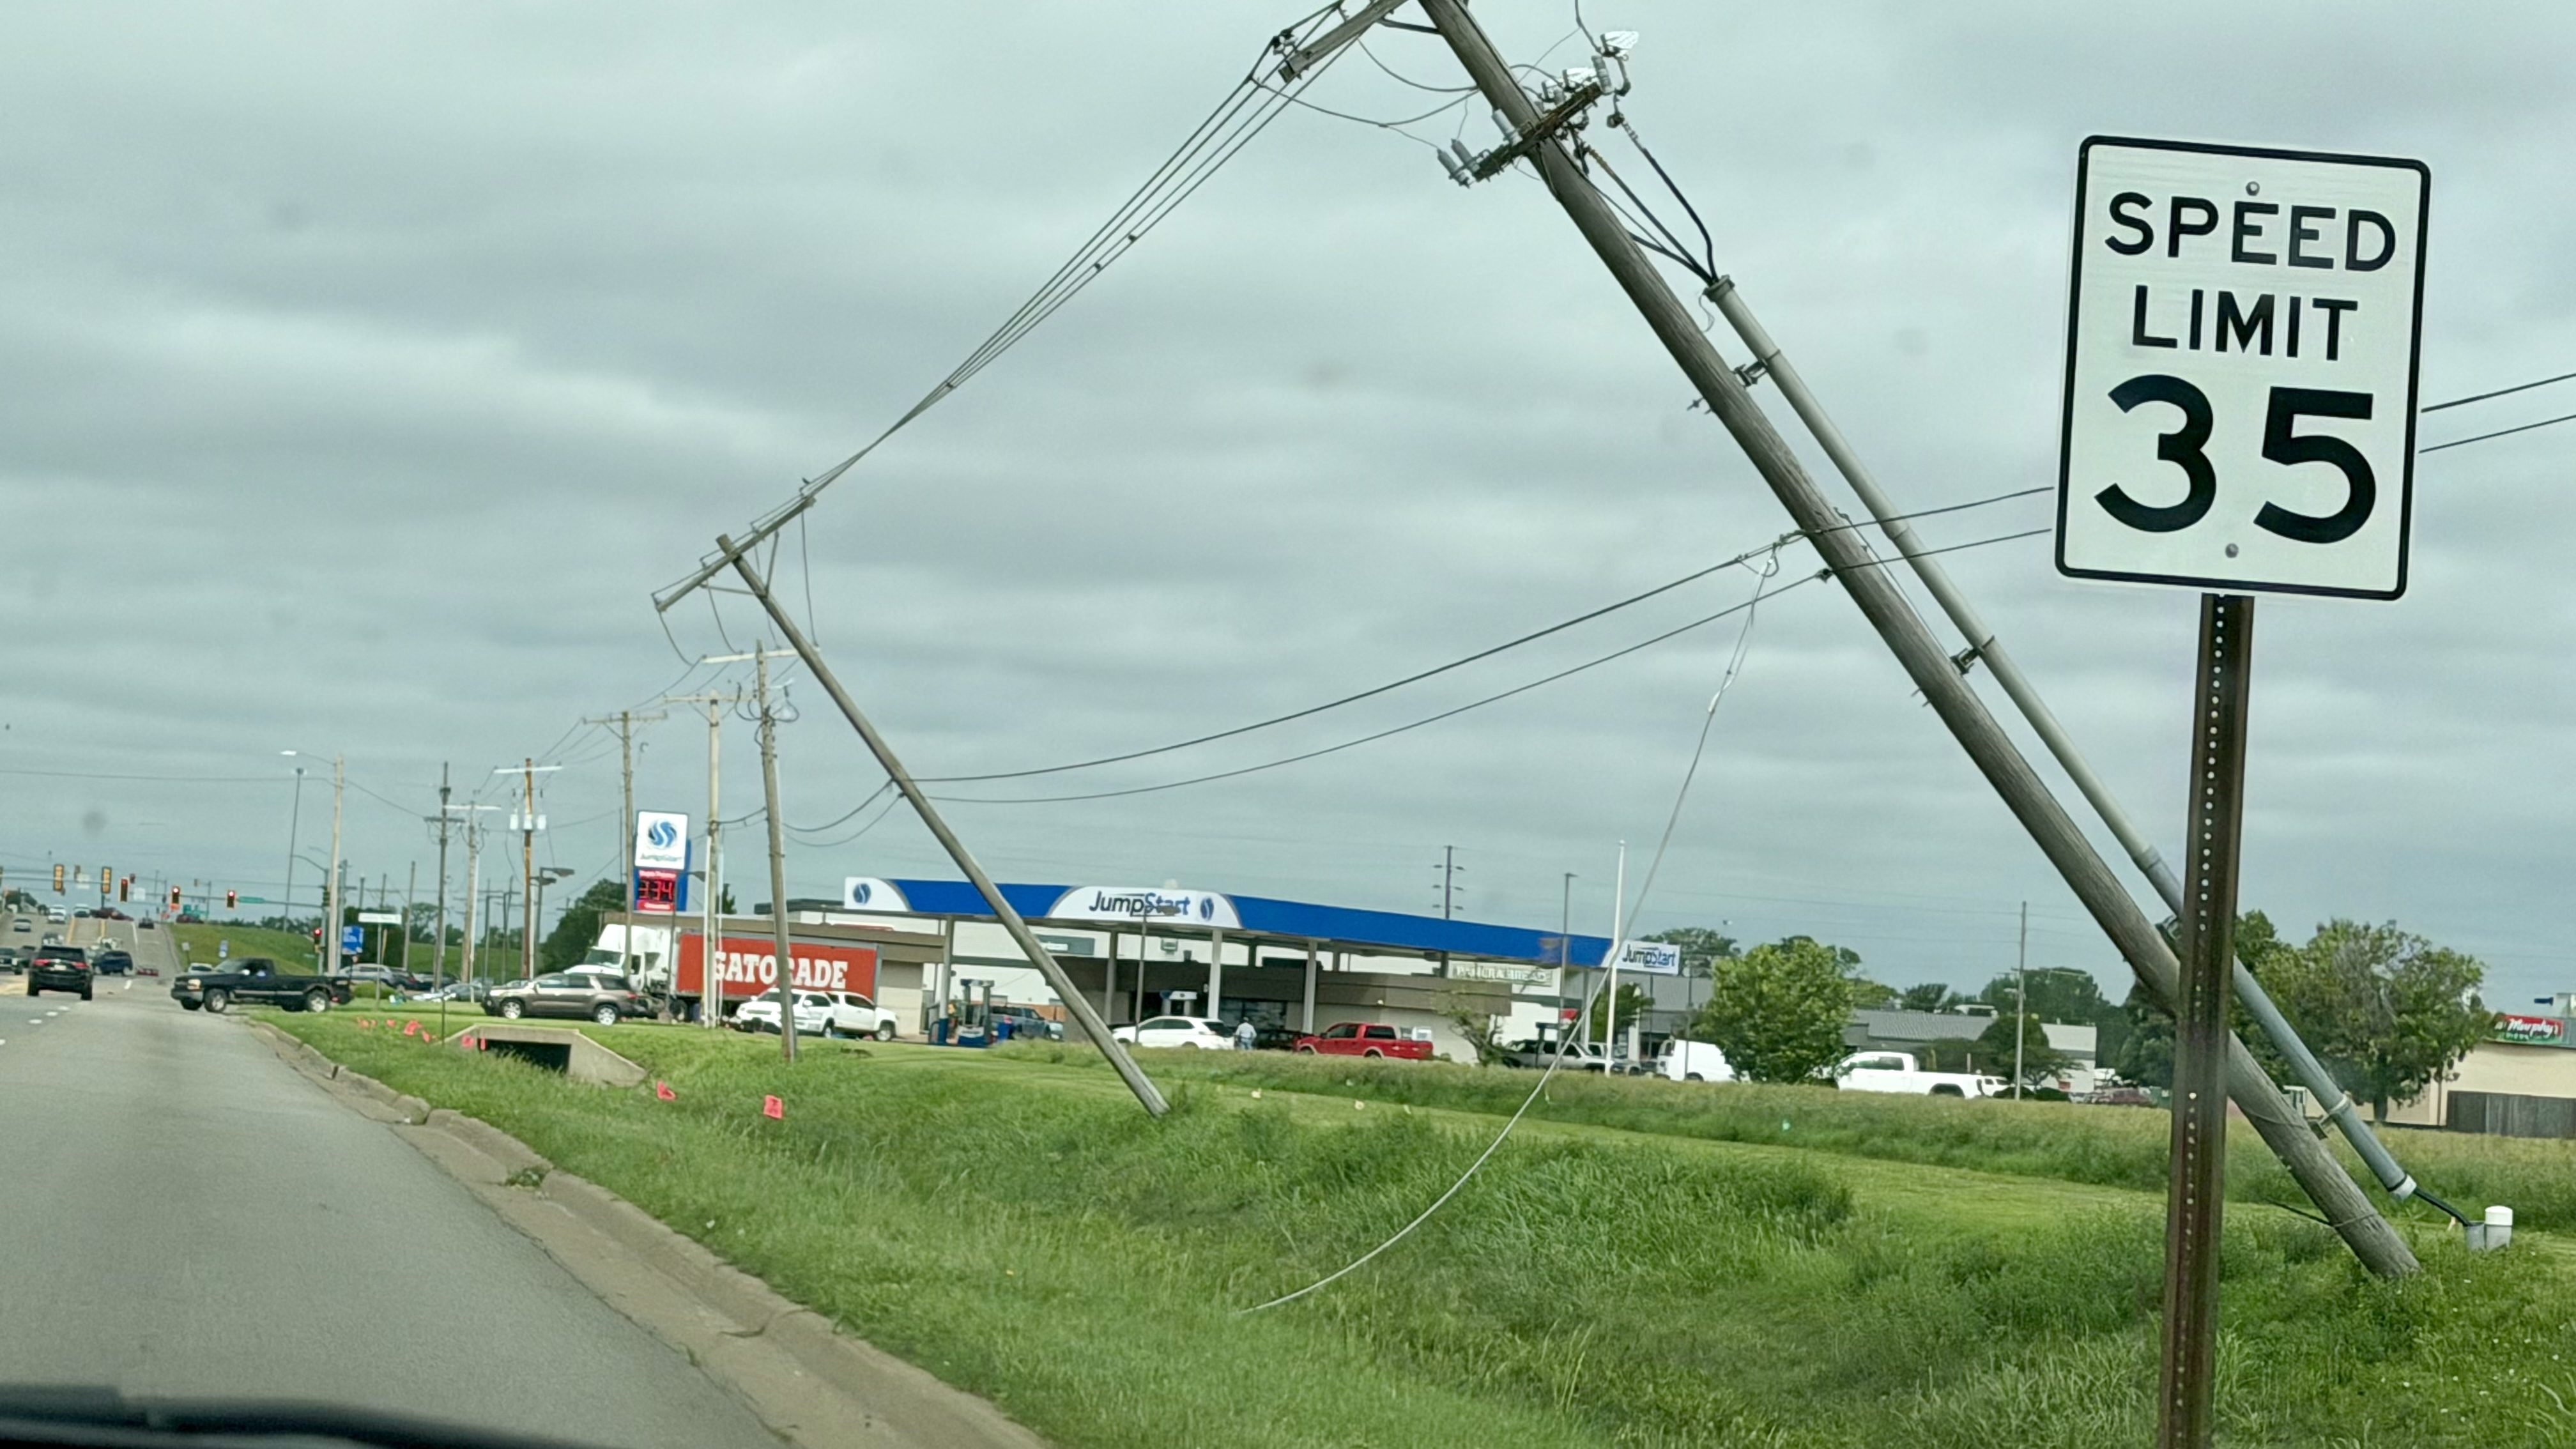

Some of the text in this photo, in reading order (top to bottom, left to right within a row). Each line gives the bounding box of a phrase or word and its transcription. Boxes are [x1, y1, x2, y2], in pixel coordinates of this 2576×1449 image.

[2104, 192, 2396, 272] SPEED
[2133, 285, 2358, 361] LIMIT
[2094, 374, 2377, 544] 35
[1088, 891, 1191, 917] JumpStart
[1622, 944, 1676, 967] JumpStart
